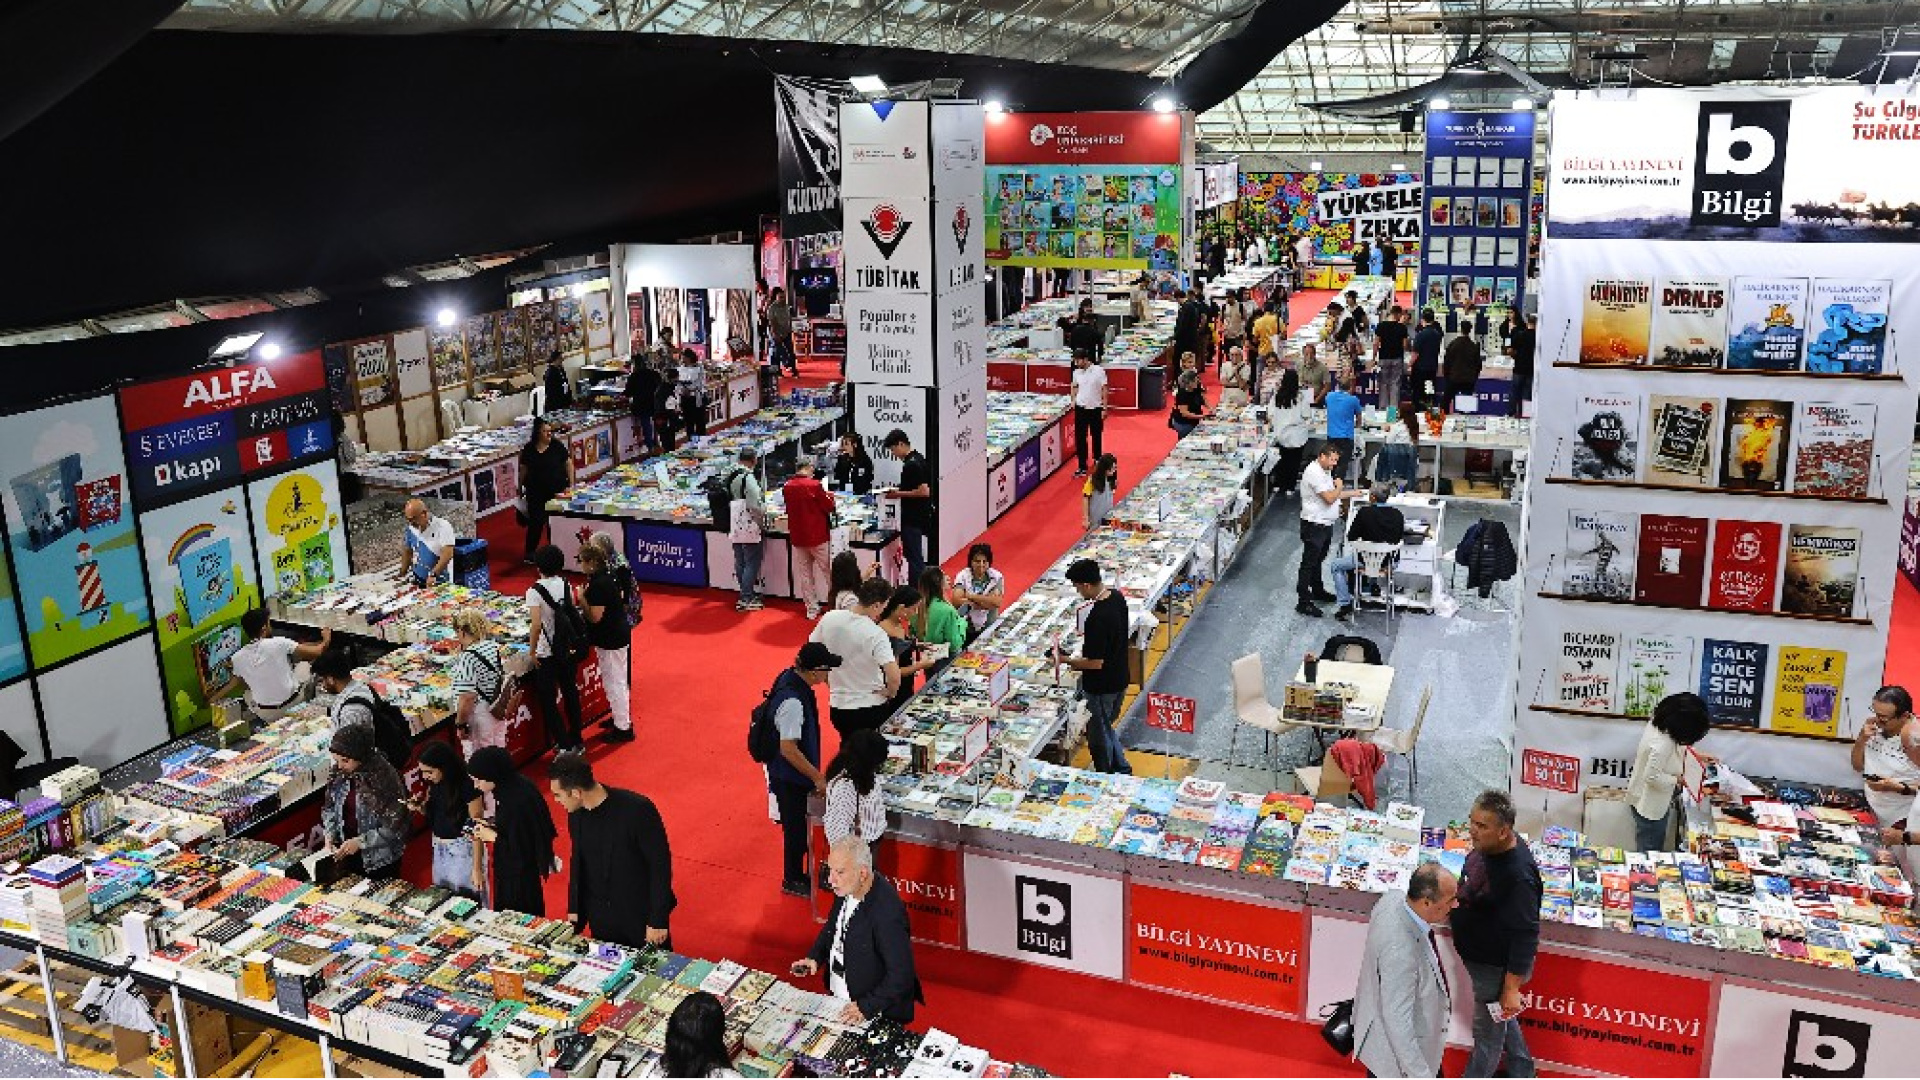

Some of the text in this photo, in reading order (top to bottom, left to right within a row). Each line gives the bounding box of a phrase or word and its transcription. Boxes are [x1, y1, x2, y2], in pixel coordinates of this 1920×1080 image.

[1852, 100, 1876, 121] Şu
[1701, 190, 1772, 221] Bilgi
[1360, 217, 1420, 238] ZEKA
[856, 265, 921, 290] TÜBİTAK
[182, 366, 277, 408] ALFA
[867, 395, 900, 410] Bilim
[1712, 646, 1759, 662] KALK
[1710, 659, 1757, 678] ÖNCE
[1709, 676, 1755, 695] SEN
[1552, 769, 1567, 785] TL
[1590, 756, 1634, 780] Bil
[892, 875, 956, 901] YINEVİ
[1022, 928, 1066, 953] Bilgi
[1137, 922, 1298, 967] BİLGİ YAYINEVİ
[1139, 945, 1294, 985] www.bilgiyayinevi.com.tr
[1581, 1002, 1701, 1037] YAYINEVİ
